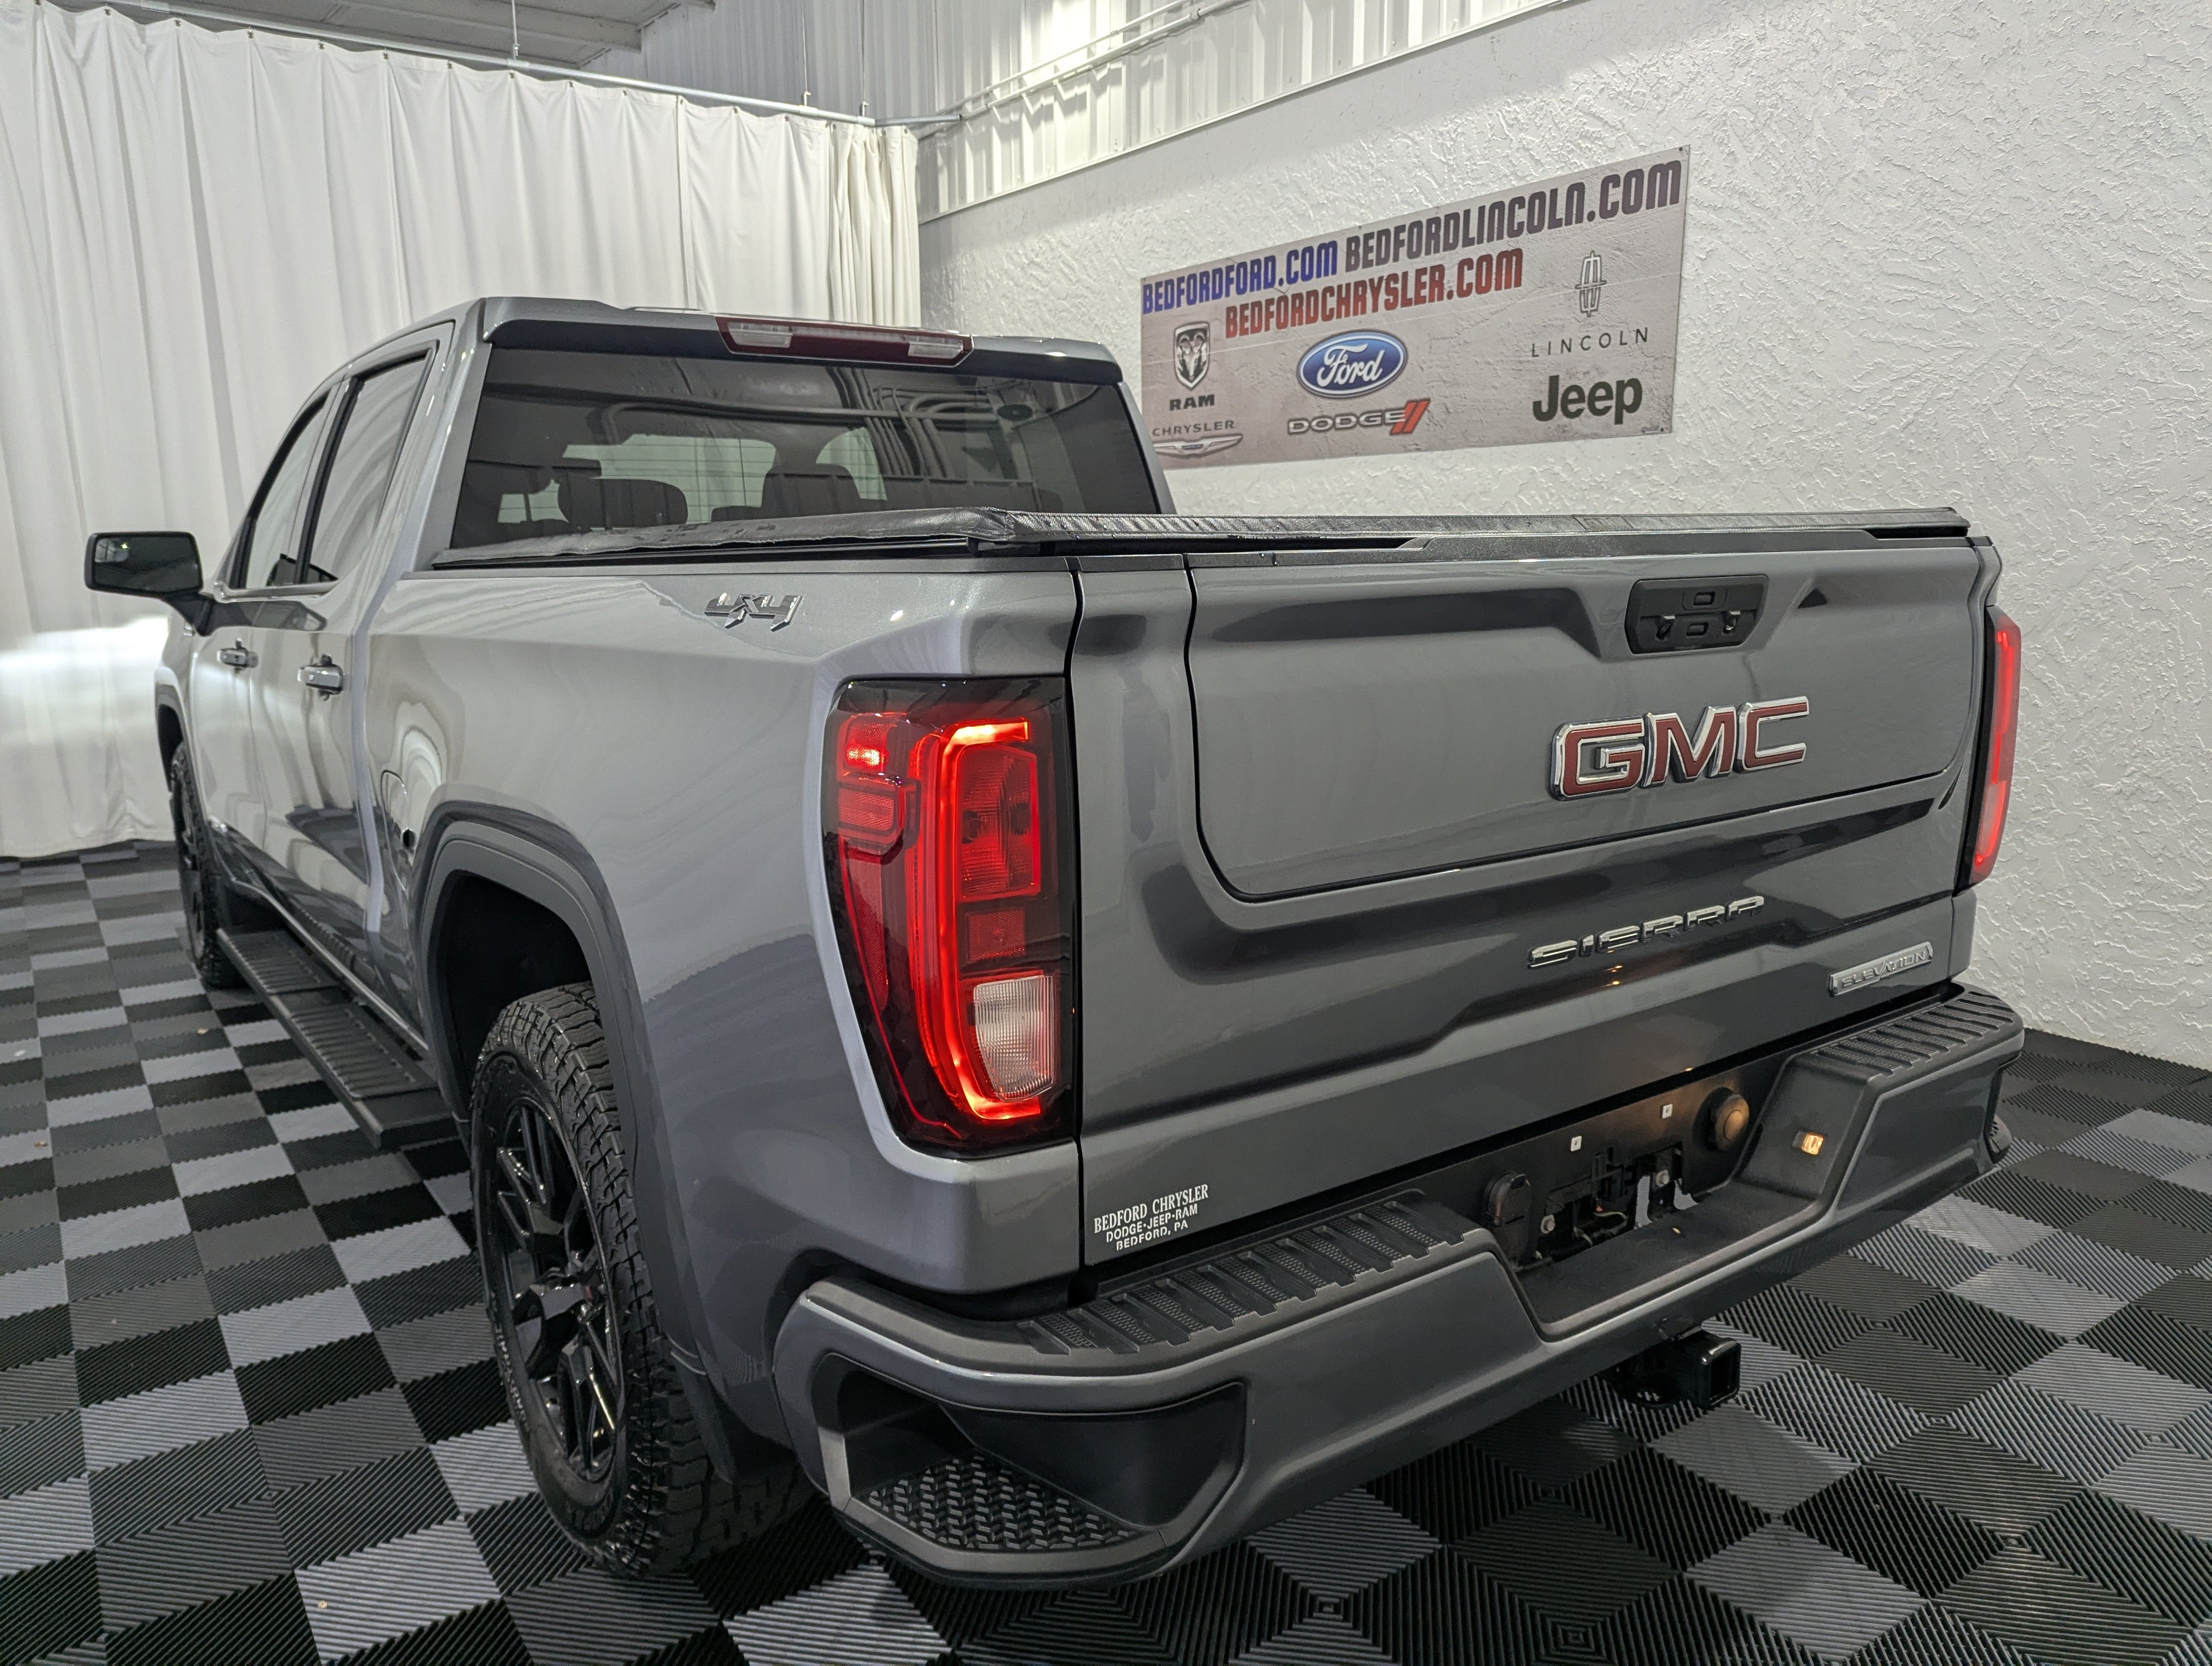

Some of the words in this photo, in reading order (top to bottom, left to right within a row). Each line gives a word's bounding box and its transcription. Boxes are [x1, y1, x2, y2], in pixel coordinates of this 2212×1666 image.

[1142, 240, 1338, 316] BEDFORDFORD.COM
[1345, 159, 1682, 272] BEDFORDLINCOLN.COM
[1225, 247, 1524, 339] BEDFORDCHRYSLER.COM
[1316, 342, 1386, 387] Ford
[1531, 327, 1648, 358] LINCOLN
[1169, 394, 1216, 412] RAM
[1287, 408, 1407, 435] DODGE
[1532, 374, 1643, 426] Jeep
[1152, 420, 1235, 437] CHRYSLER
[1550, 695, 1810, 802] GMC
[1528, 895, 1765, 969] SIERRA
[1842, 950, 1926, 989] ELEVATION
[1094, 1203, 1148, 1234] BEDFORD
[1152, 1183, 1209, 1215] CHRYSLER
[1116, 1226, 1172, 1251] BEDFORD,
[1174, 1219, 1188, 1232] PA
